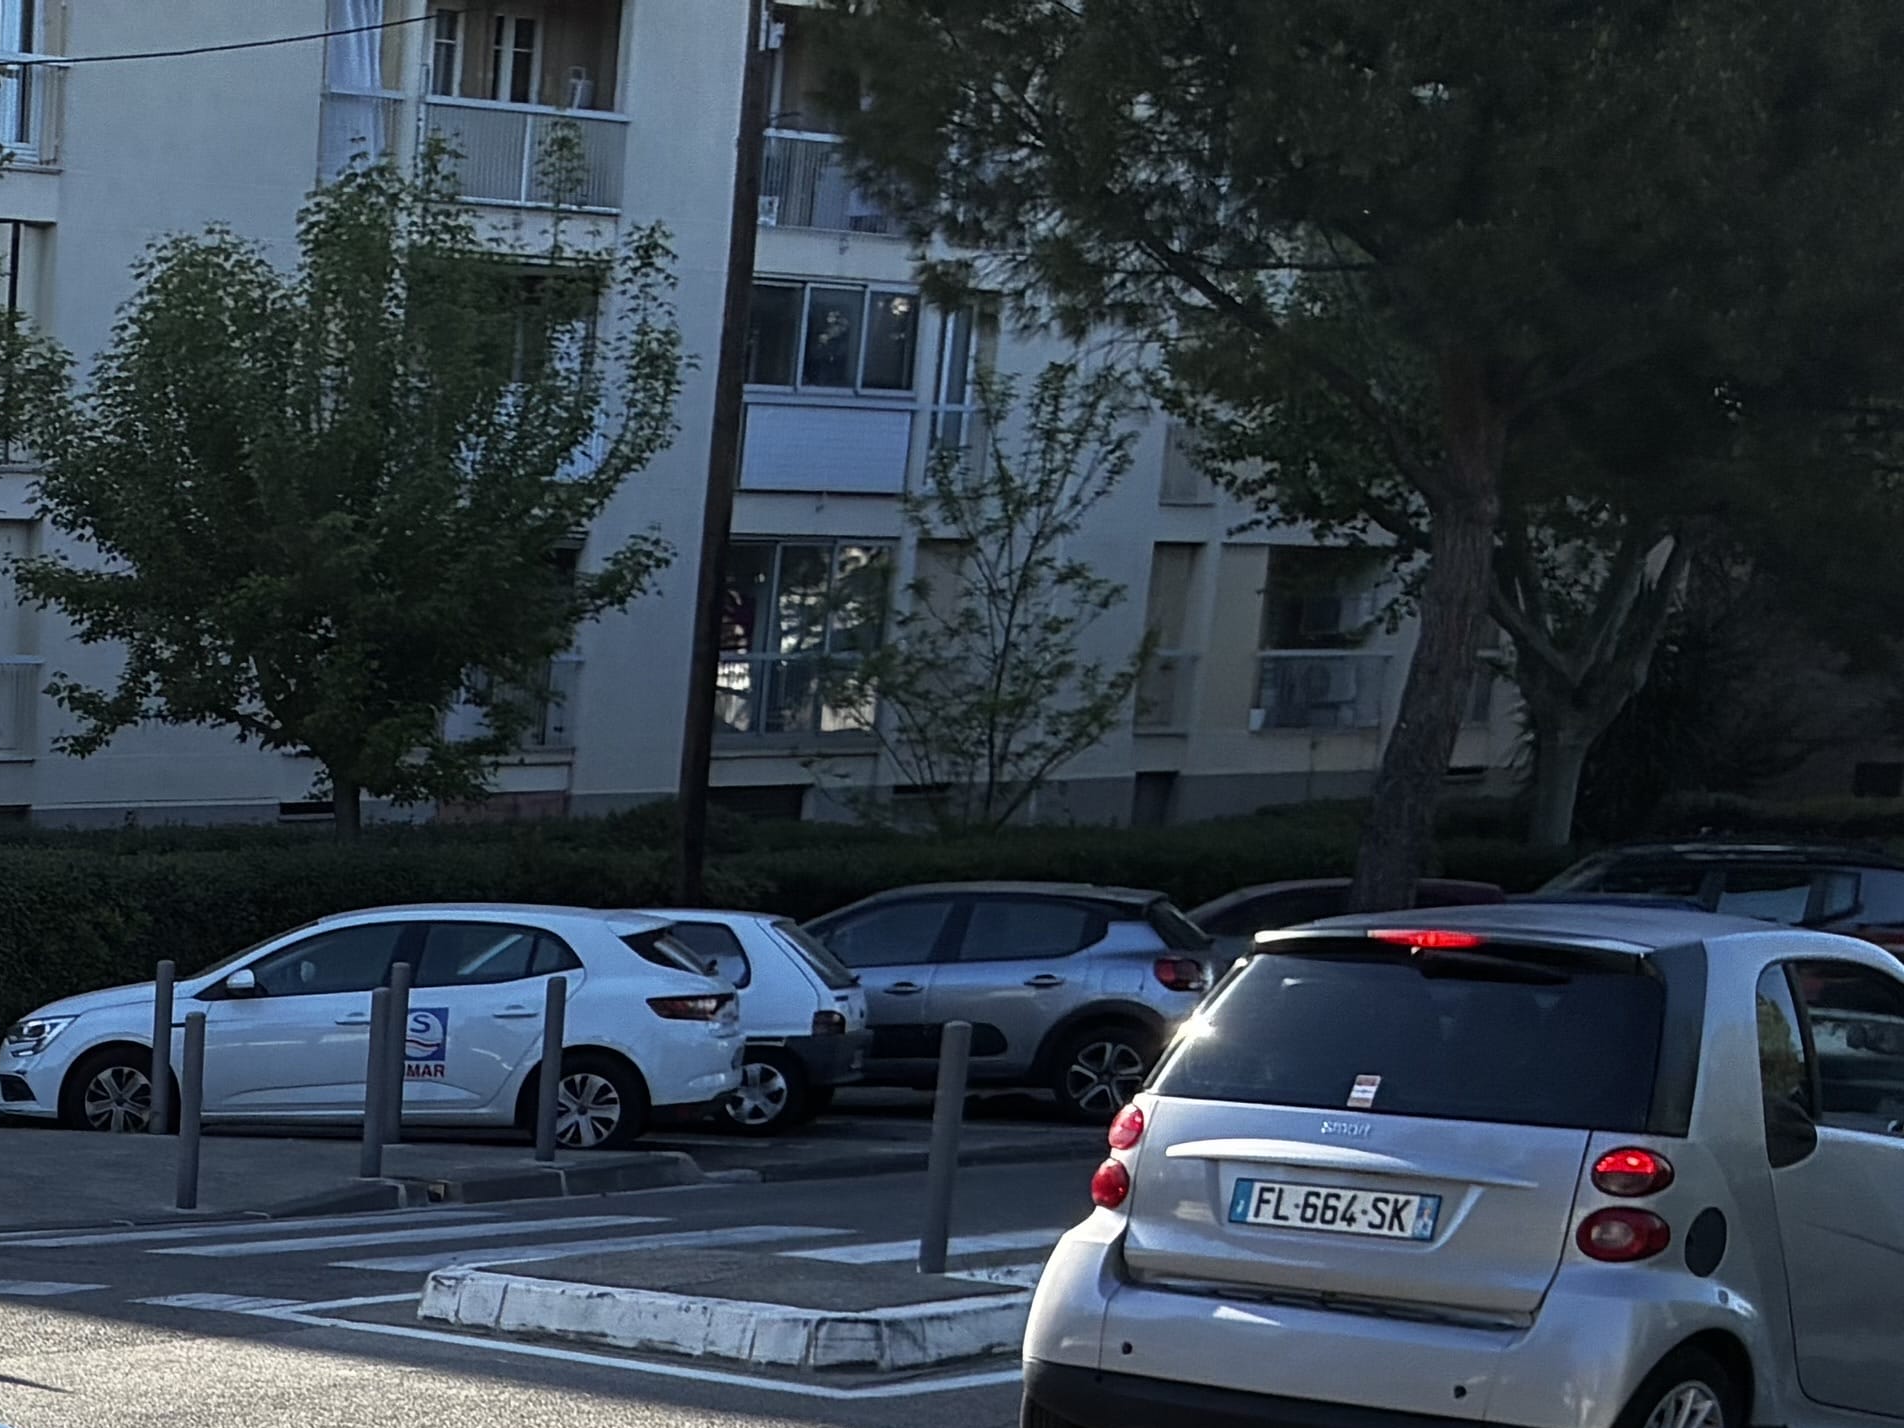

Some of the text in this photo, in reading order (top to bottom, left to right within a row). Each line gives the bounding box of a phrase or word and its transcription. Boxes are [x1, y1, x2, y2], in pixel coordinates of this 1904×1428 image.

[410, 1014, 431, 1034] S
[406, 1064, 446, 1078] MAR
[1323, 1121, 1371, 1137] smart
[1253, 1187, 1411, 1233] FL-664-SK
